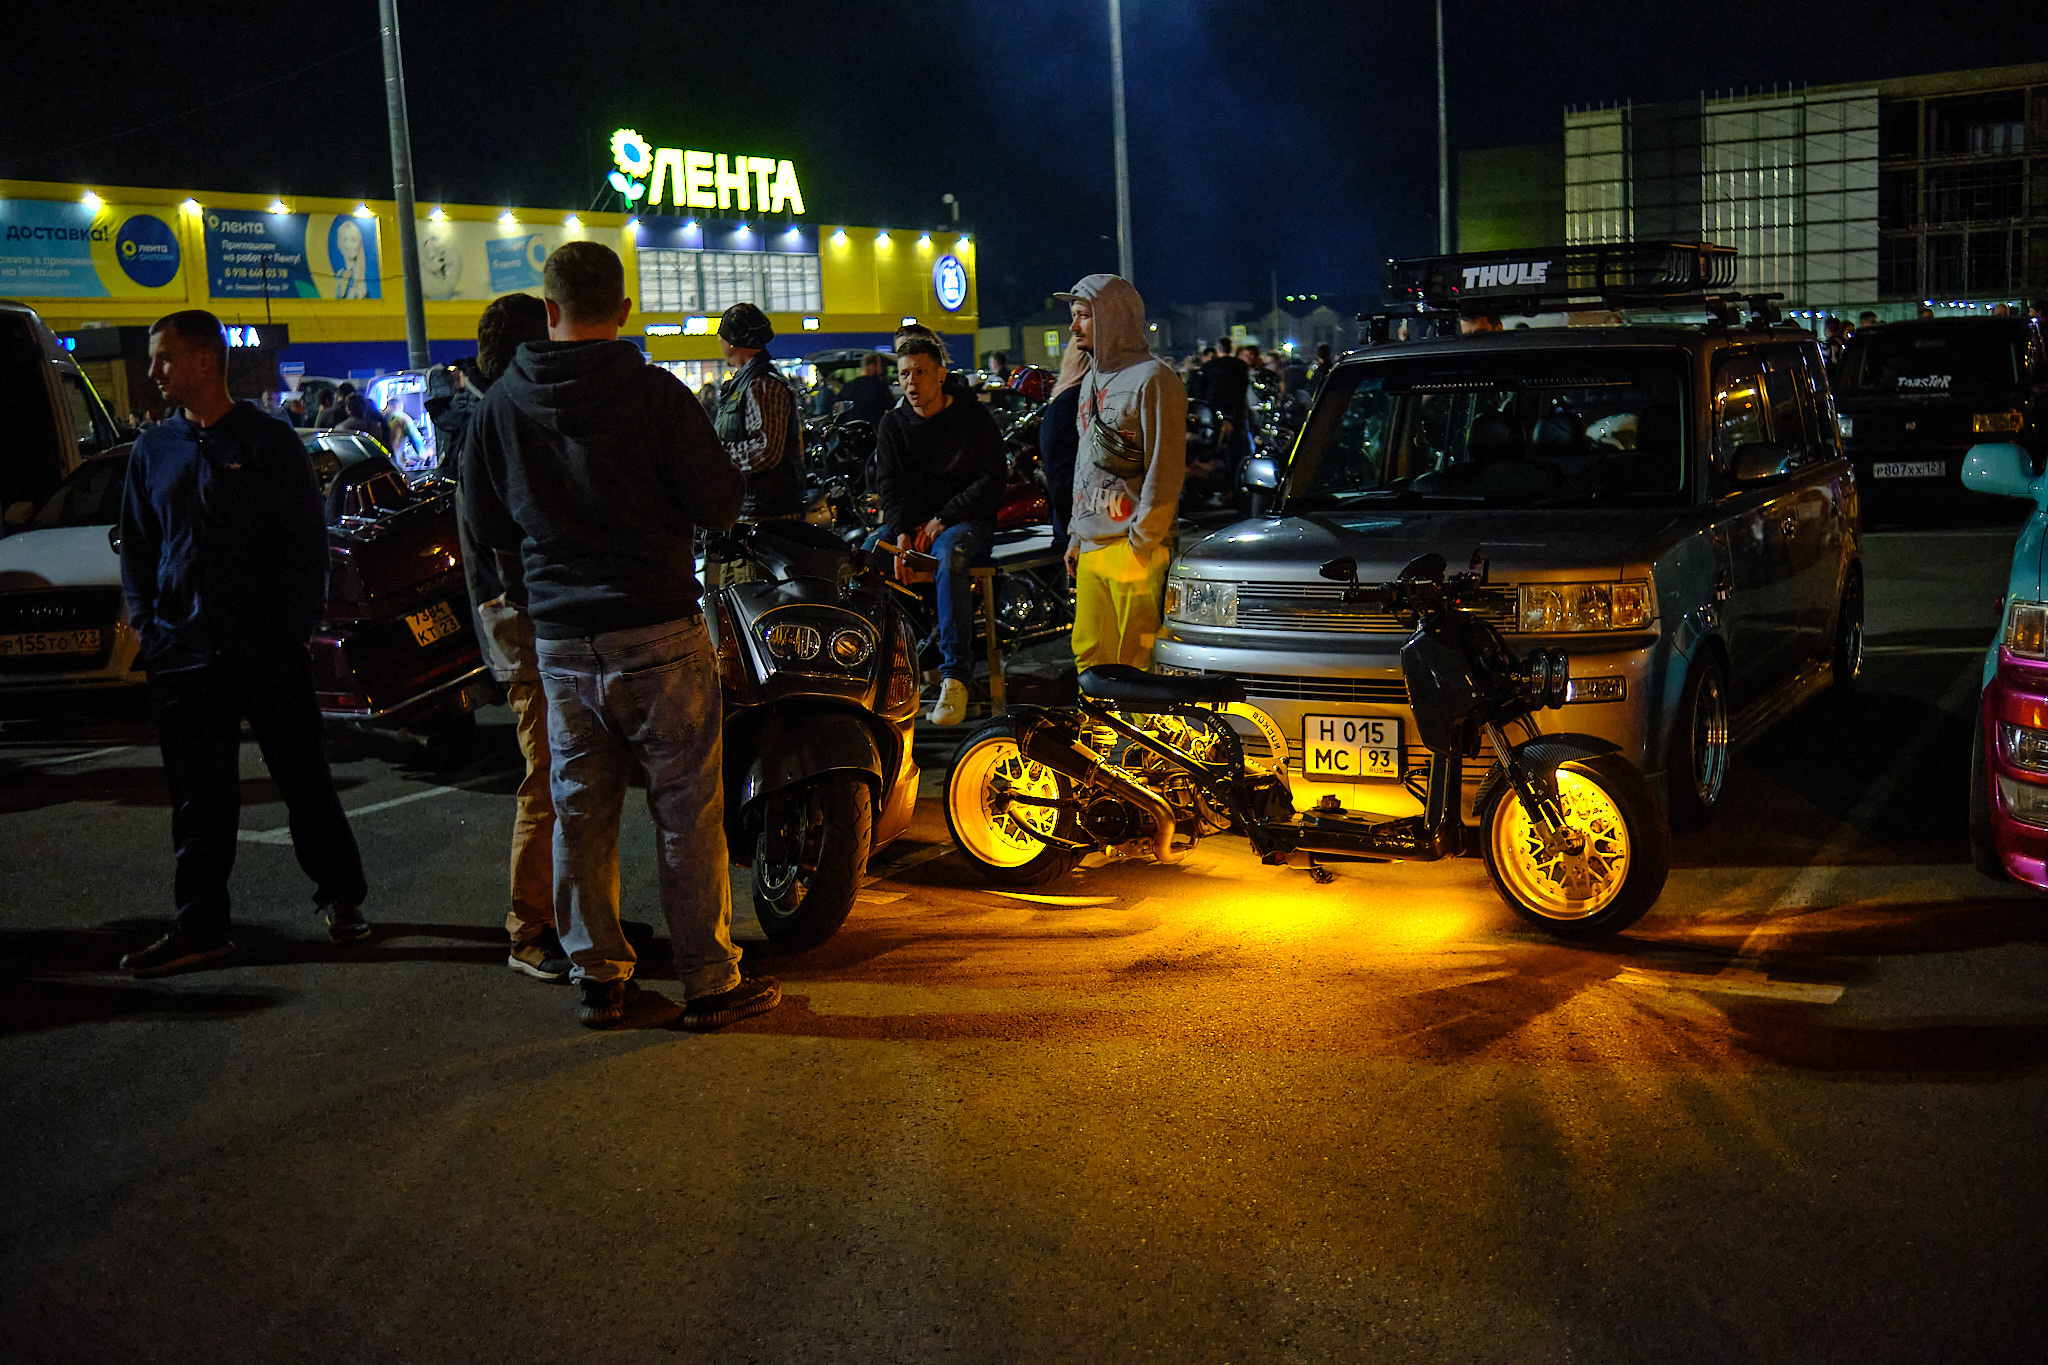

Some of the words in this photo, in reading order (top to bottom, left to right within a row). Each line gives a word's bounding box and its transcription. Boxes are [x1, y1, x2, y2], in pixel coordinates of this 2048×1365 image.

[648, 147, 805, 215] ЛЕНТА
[7, 225, 109, 242] доставка!
[221, 220, 265, 234] лента
[1462, 261, 1548, 289] THULE
[1085, 487, 1125, 518] JPN
[72, 631, 97, 645] 123
[418, 626, 436, 644] КТ
[440, 617, 457, 634] 23
[1320, 720, 1334, 742] Н
[1343, 721, 1384, 744] 015
[1315, 748, 1349, 771] МС
[1368, 750, 1390, 767] 93
